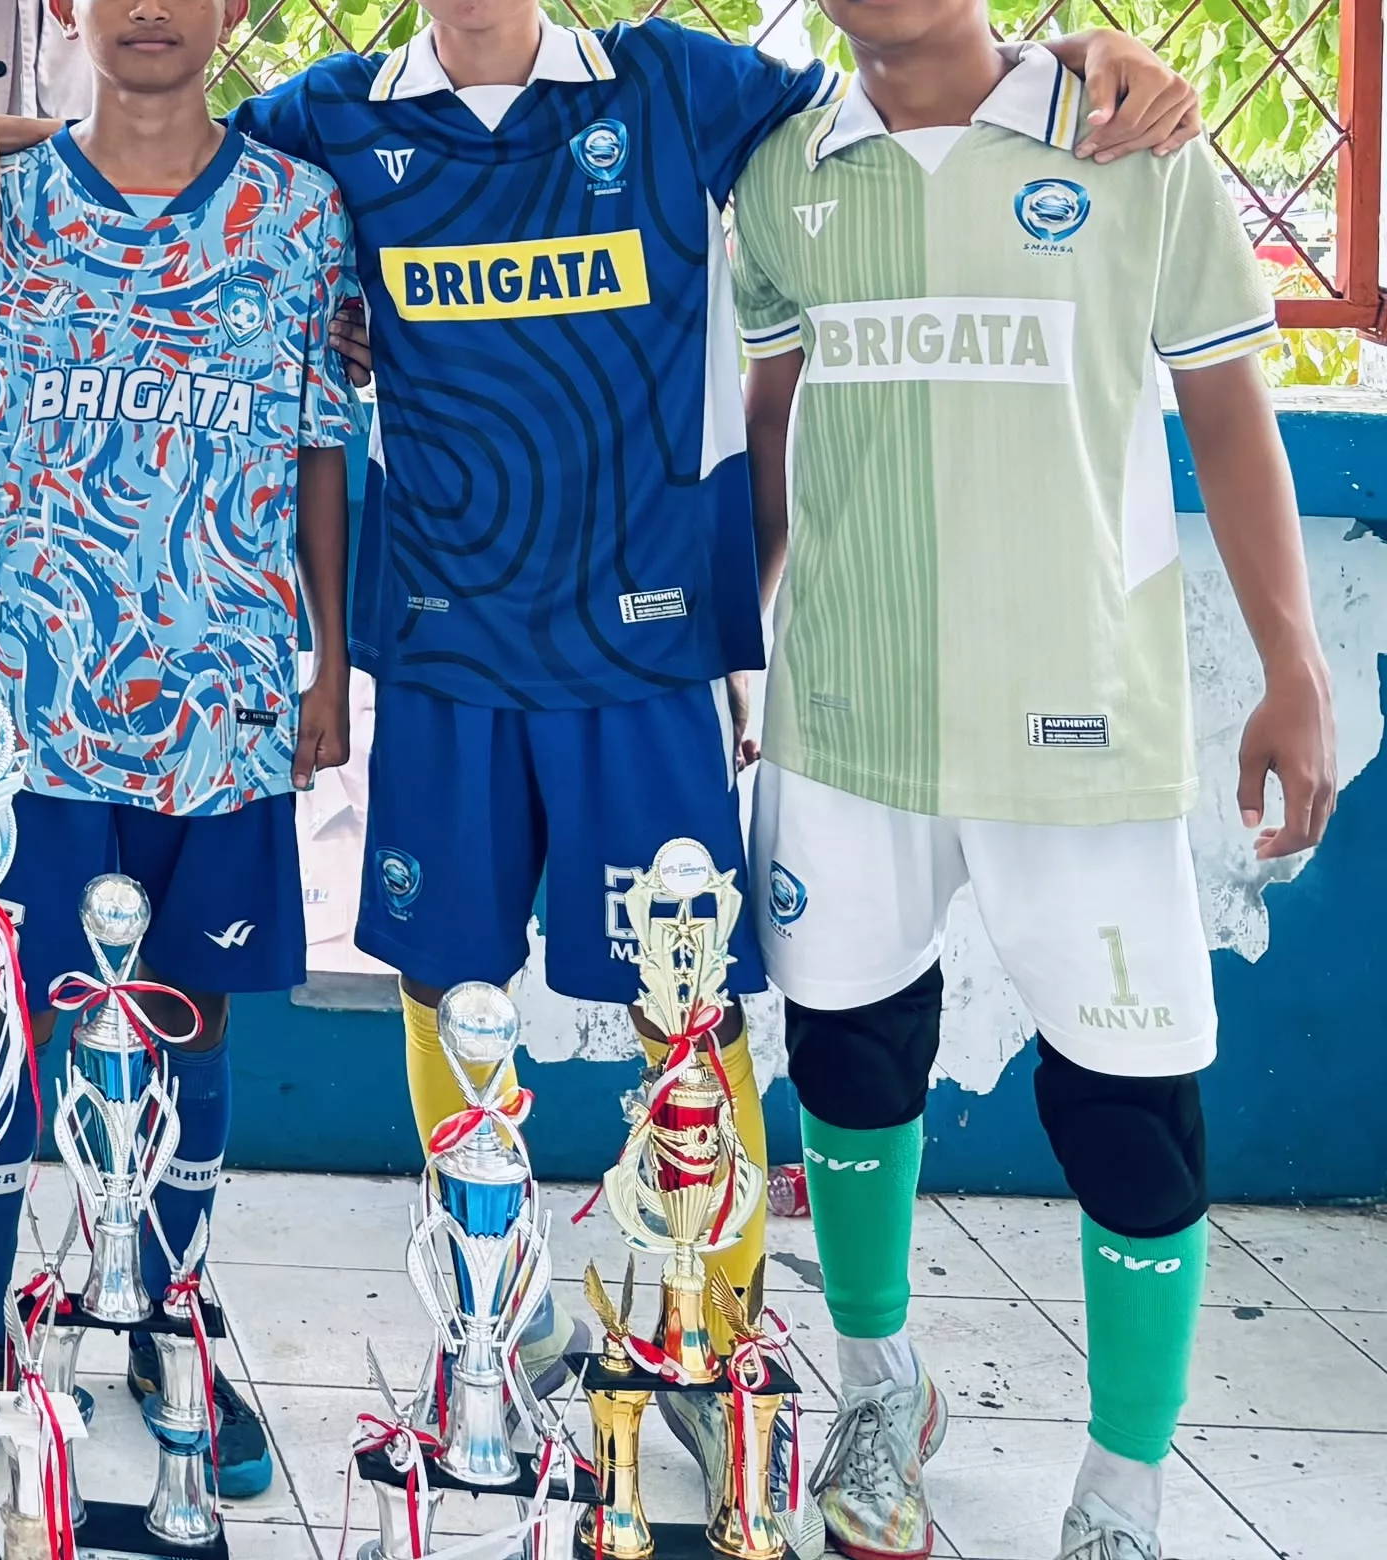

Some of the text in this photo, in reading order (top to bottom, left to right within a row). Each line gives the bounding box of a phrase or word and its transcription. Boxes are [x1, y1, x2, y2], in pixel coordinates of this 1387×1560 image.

[1022, 243, 1073, 253] SMANSA
[404, 249, 622, 307] BRIGATA
[819, 314, 1049, 367] BRIGATA
[29, 365, 254, 435] BRIGATA
[634, 591, 680, 604] AUTHENTIC
[1045, 719, 1104, 728] AUTHENTIC
[610, 941, 694, 960] MR
[1099, 925, 1138, 1005] 1
[1078, 1002, 1176, 1030] MNVR
[804, 1147, 880, 1172] avo
[1099, 1245, 1181, 1274] avo
